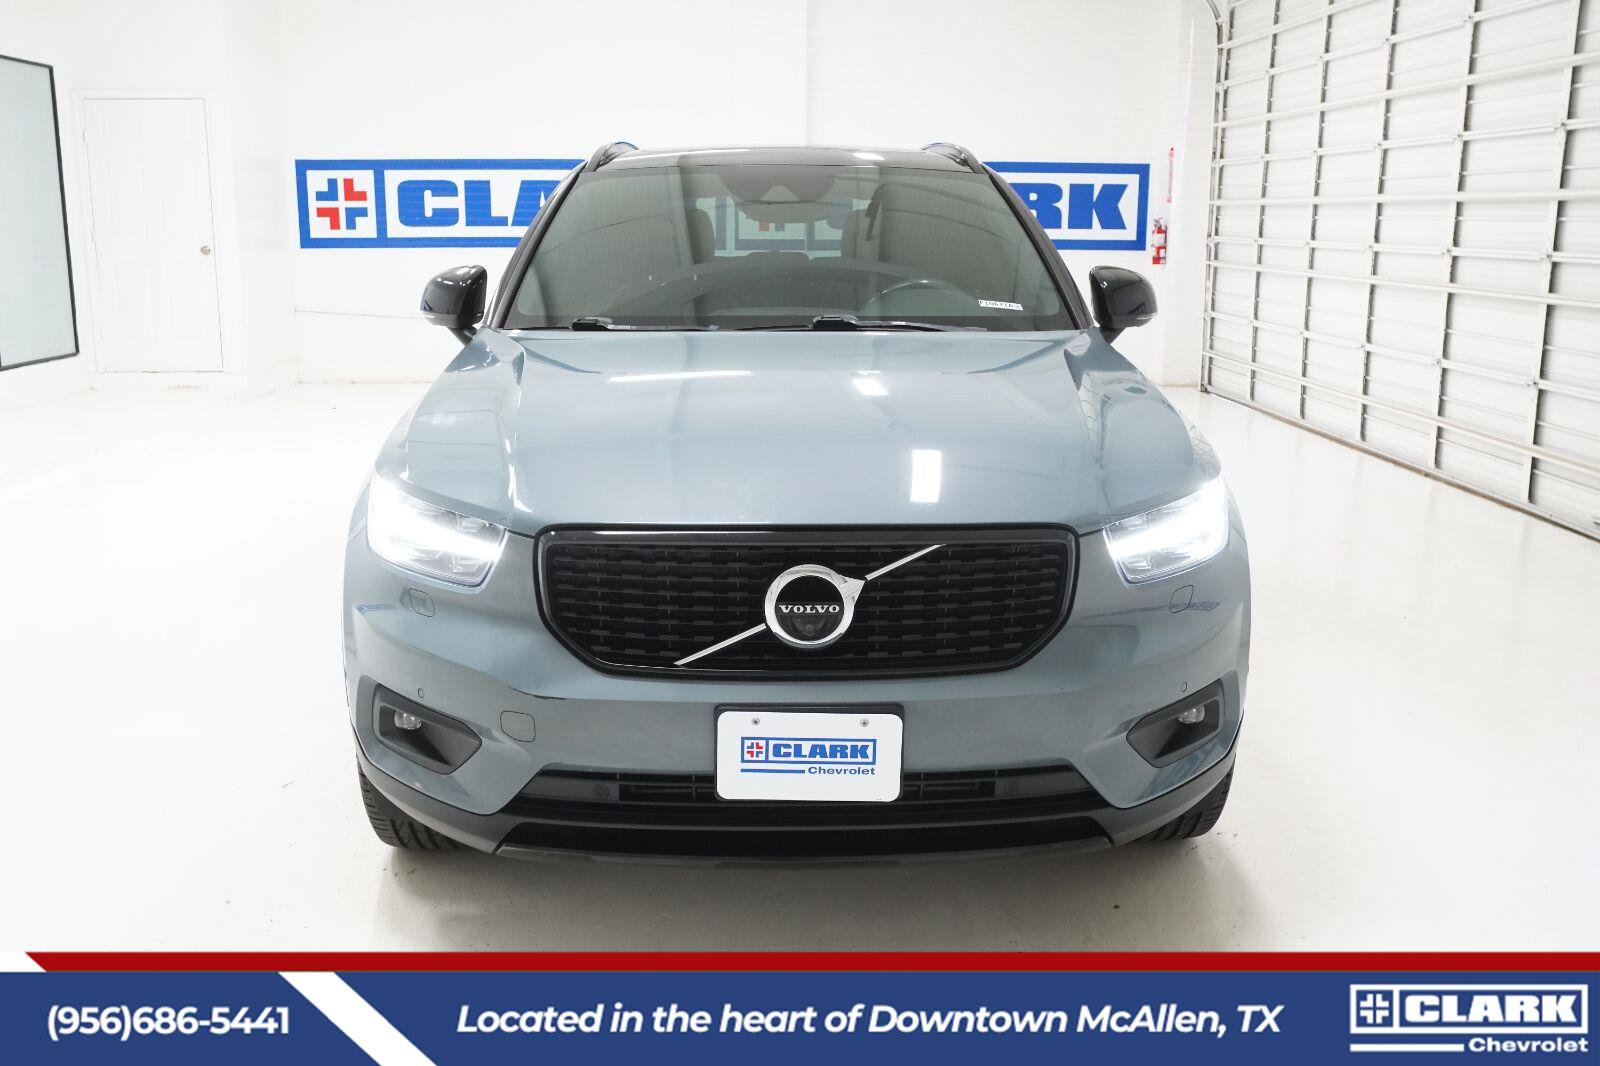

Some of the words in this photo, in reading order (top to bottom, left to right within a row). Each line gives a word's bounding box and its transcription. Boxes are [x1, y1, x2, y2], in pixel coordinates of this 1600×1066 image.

[397, 180, 561, 227] CLA
[779, 604, 840, 613] VOLVO
[772, 743, 870, 759] CLARK
[807, 766, 876, 775] Chevrolet
